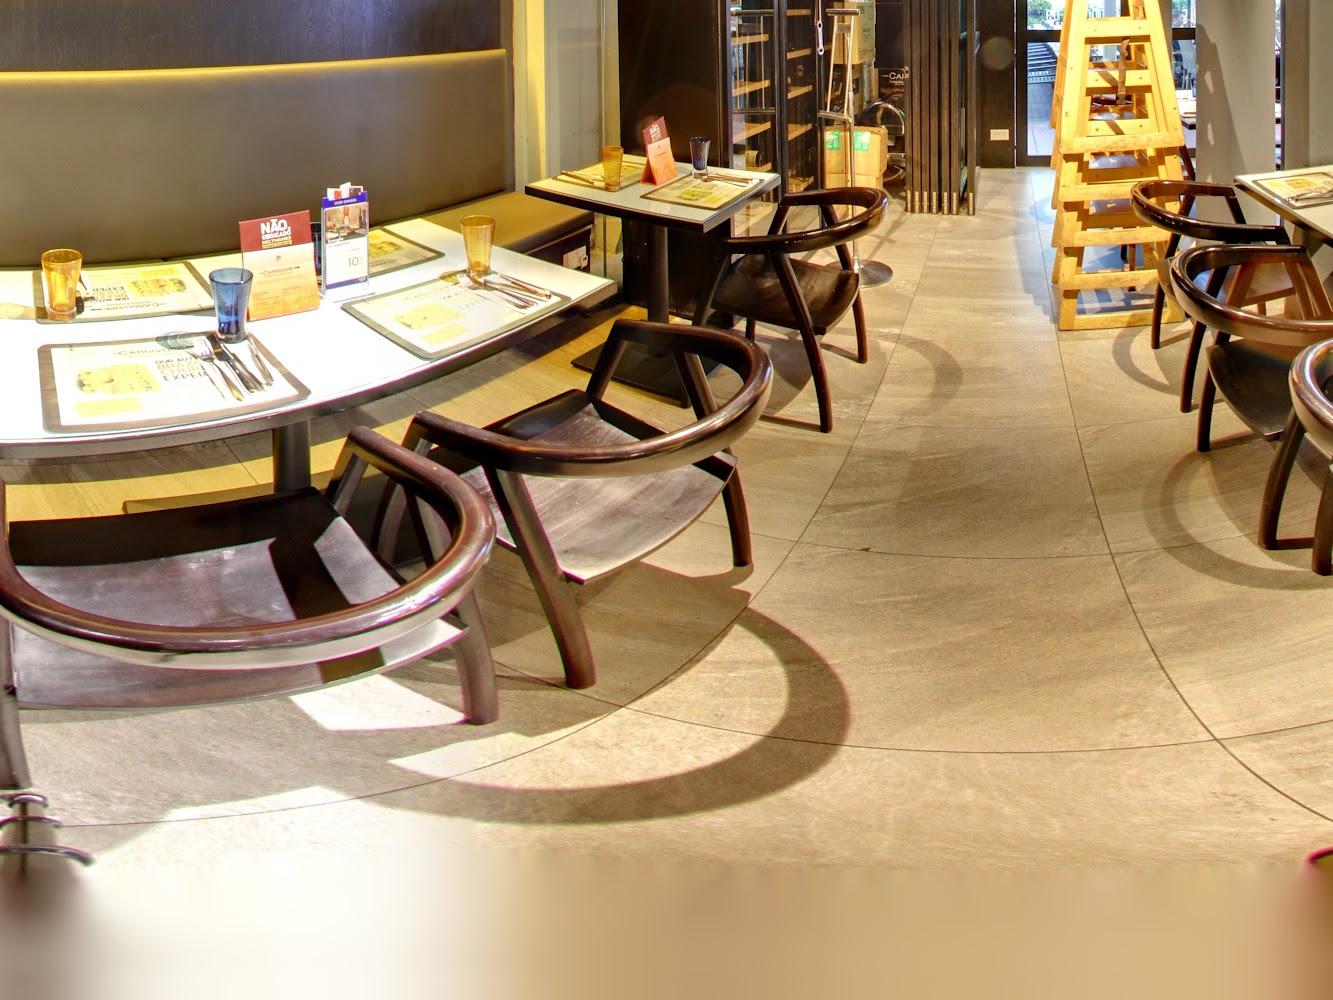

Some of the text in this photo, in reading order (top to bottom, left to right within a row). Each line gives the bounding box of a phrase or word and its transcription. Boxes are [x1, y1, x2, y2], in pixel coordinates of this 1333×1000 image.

[263, 266, 293, 275] CARNIVORE
[118, 347, 173, 356] CARNIVO
[157, 360, 199, 370] BRAZI
[160, 366, 200, 375] CHUR
[163, 371, 208, 381] EXPER
